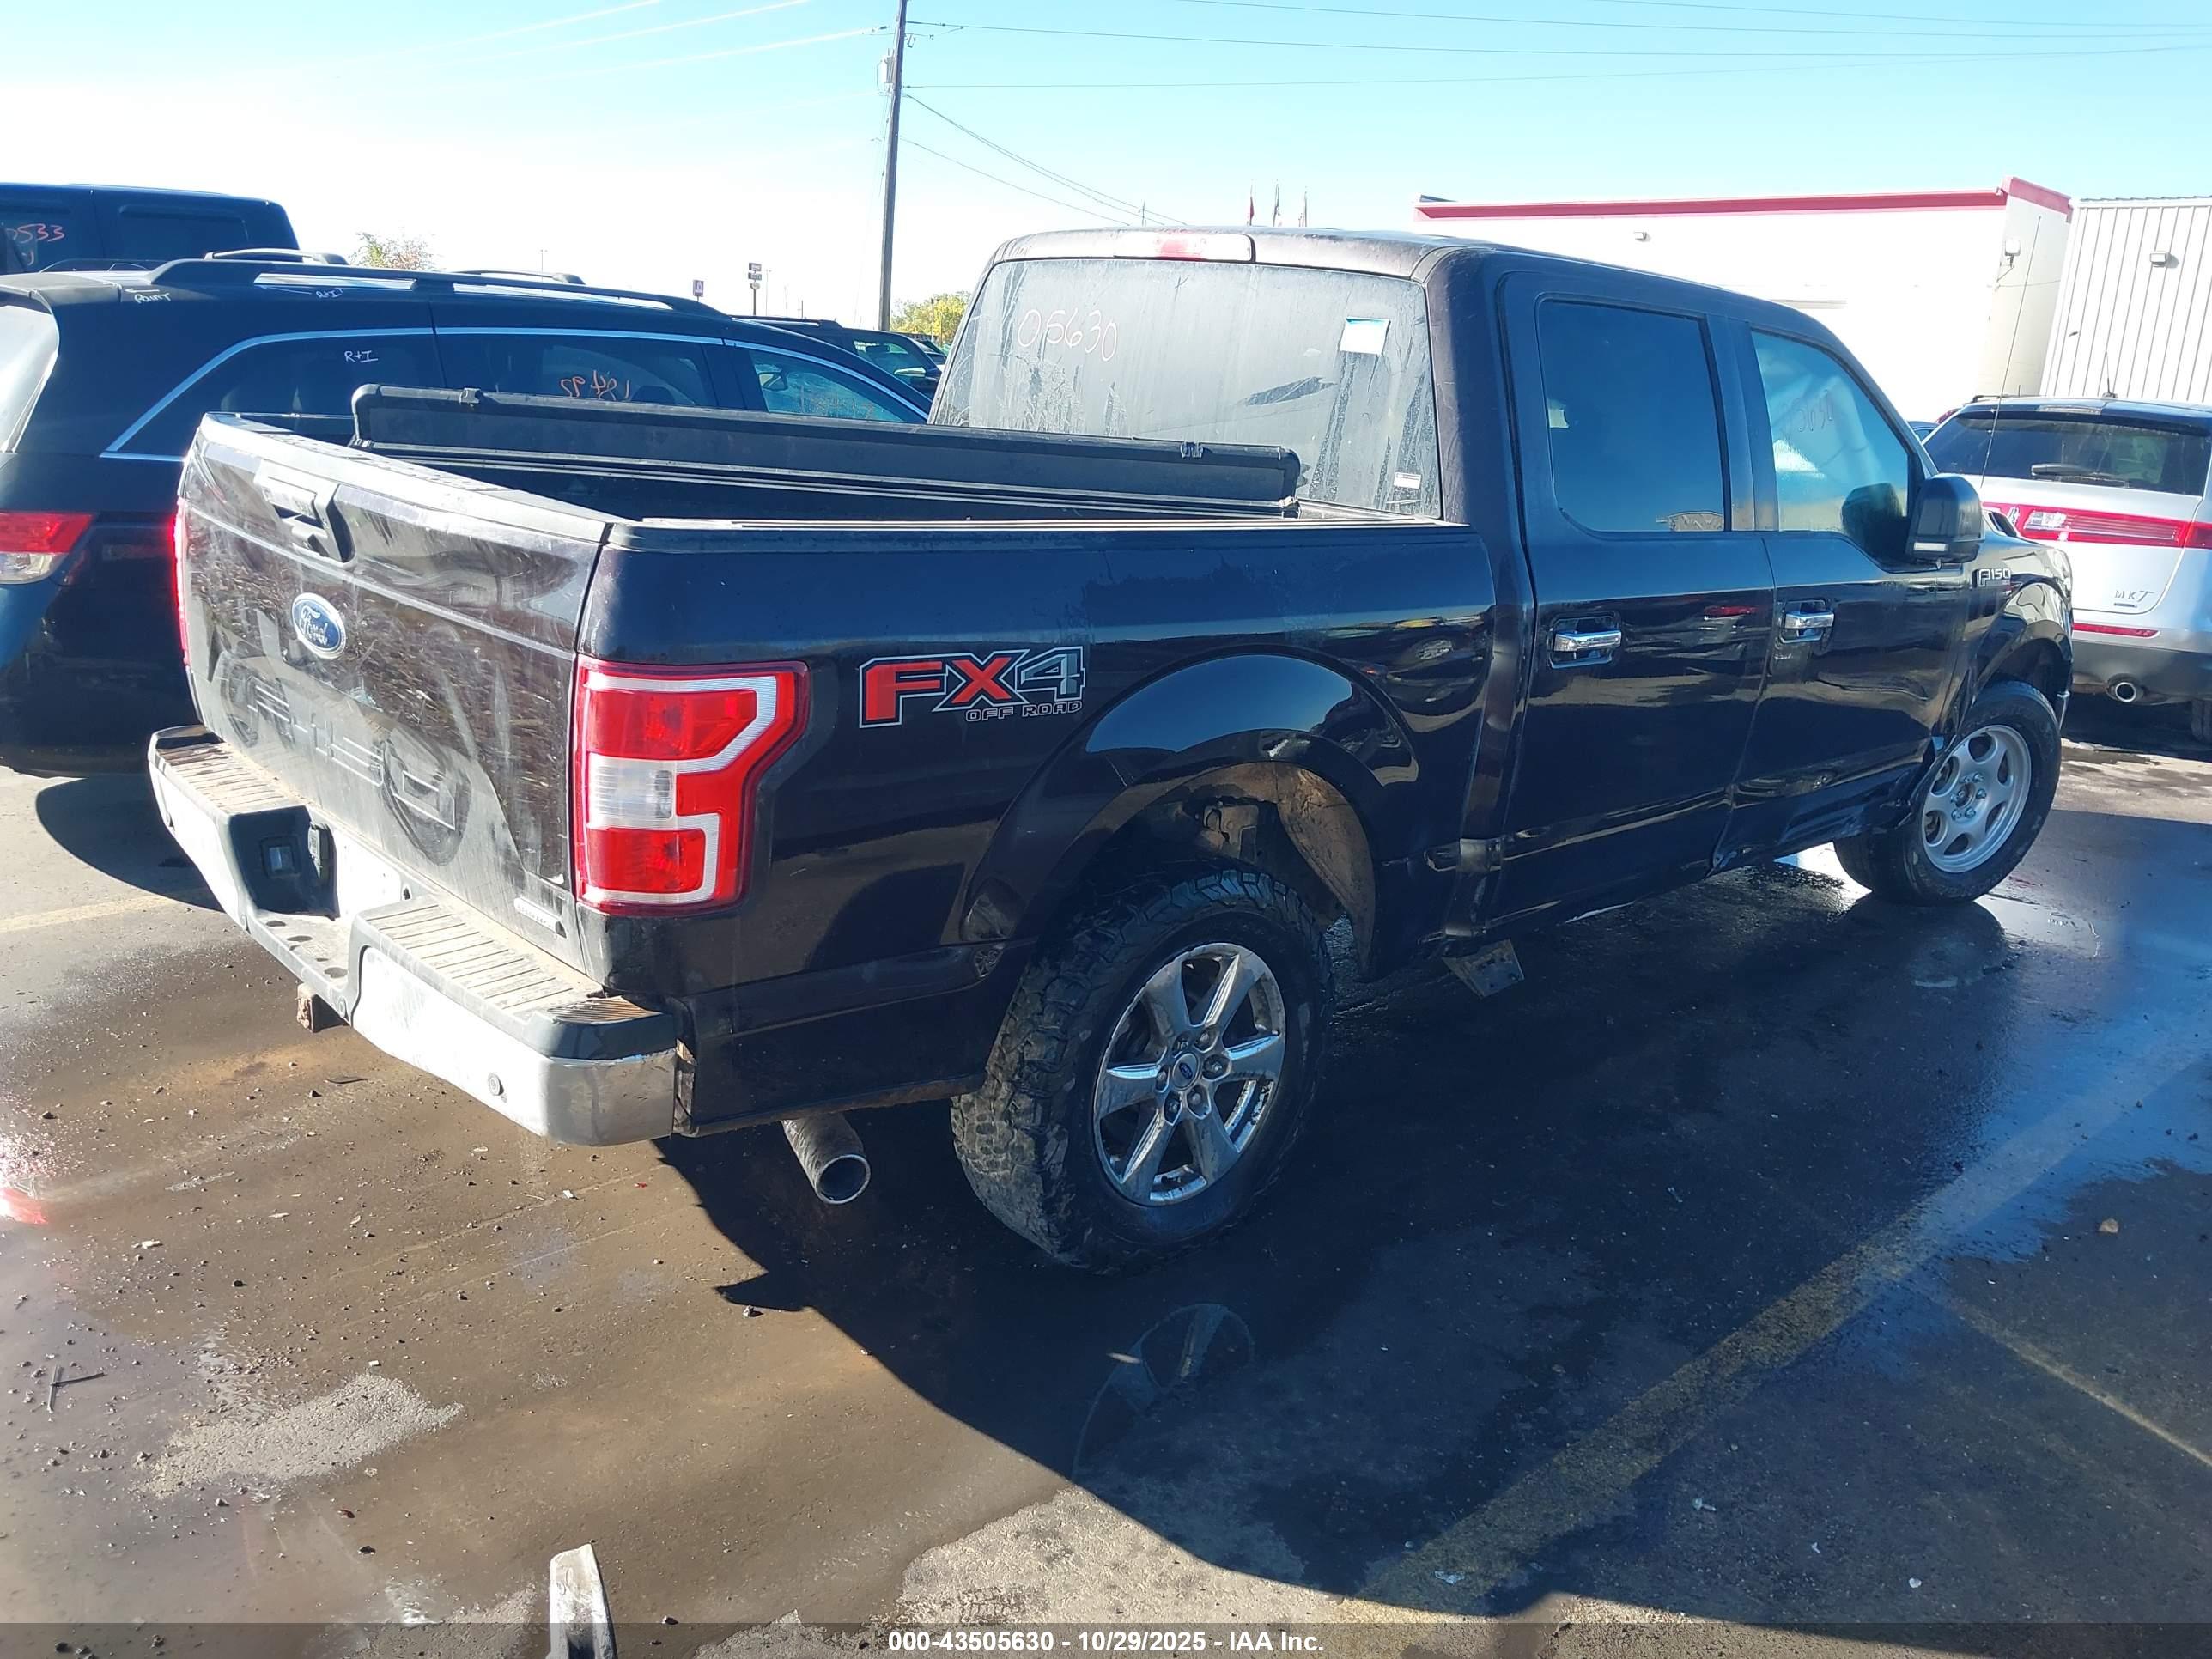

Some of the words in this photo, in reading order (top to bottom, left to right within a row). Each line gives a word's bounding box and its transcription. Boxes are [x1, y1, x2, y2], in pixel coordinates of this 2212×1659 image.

[1018, 308, 1117, 361] 05630
[344, 350, 379, 362] R+I
[2114, 590, 2154, 602] MKT
[860, 646, 1085, 728] FX4
[966, 707, 1014, 722] OFF
[1022, 701, 1083, 717] ROAD
